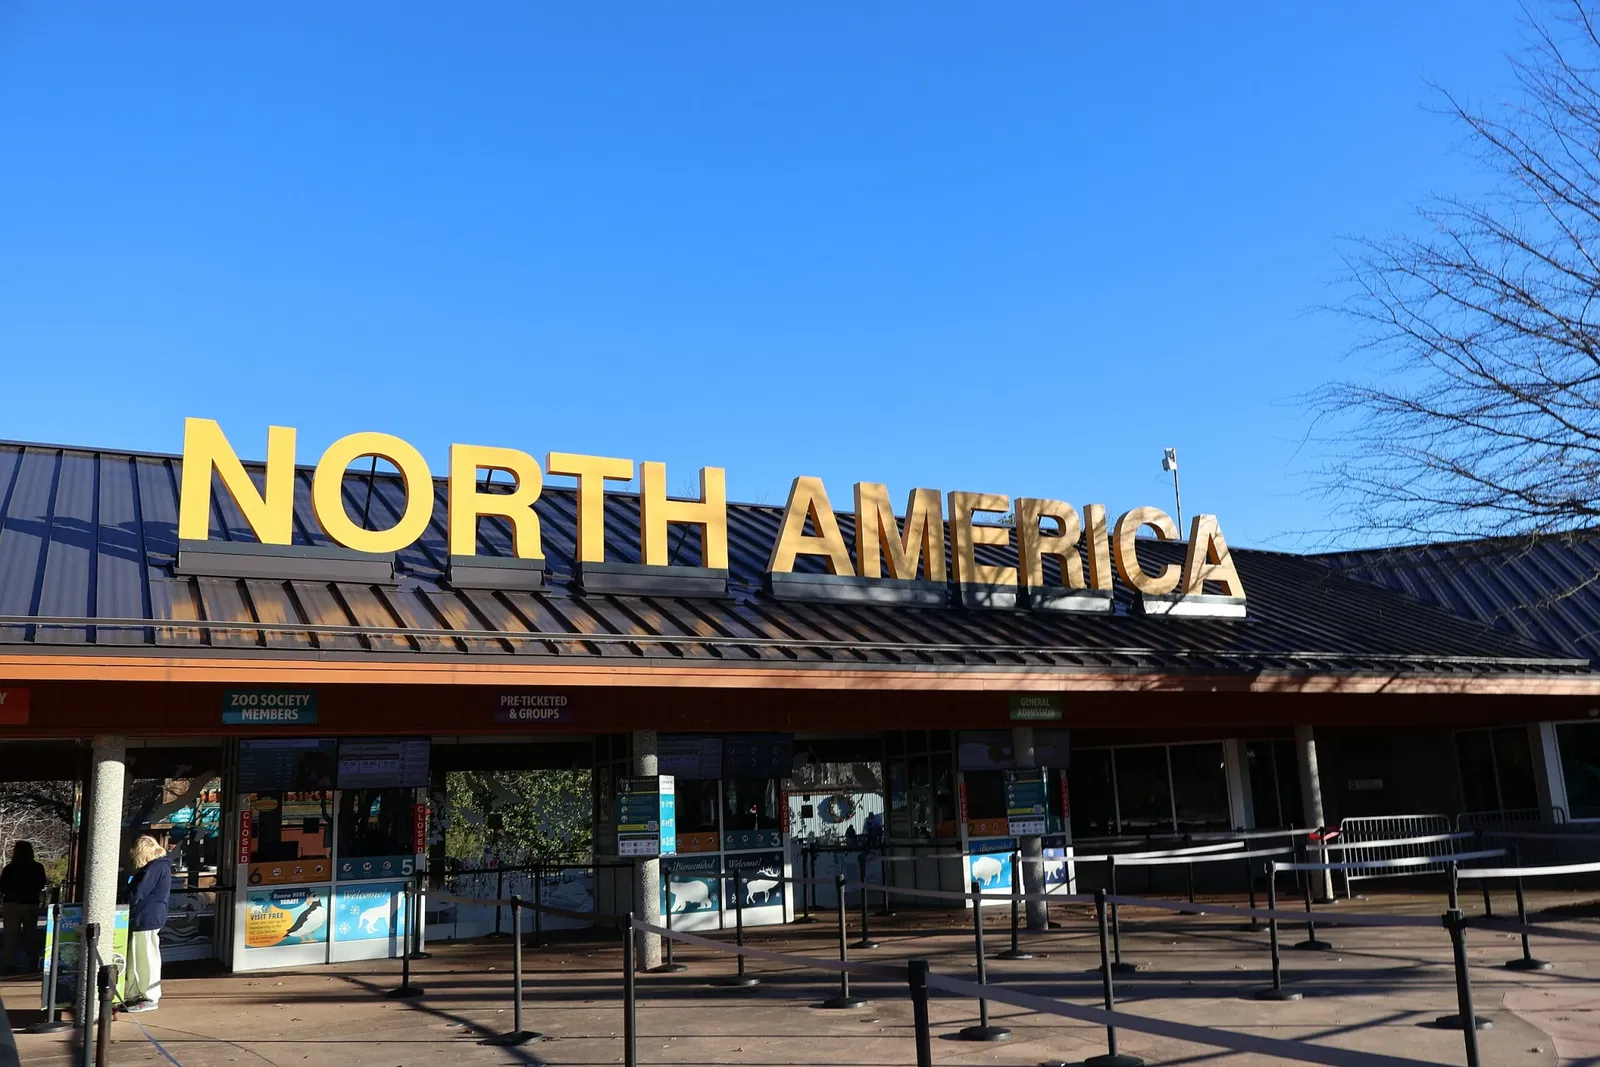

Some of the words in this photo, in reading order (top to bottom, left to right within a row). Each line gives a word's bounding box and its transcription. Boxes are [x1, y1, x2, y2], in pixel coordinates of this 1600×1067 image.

[178, 417, 729, 570] NORTH
[767, 475, 1247, 601] AMERICA
[231, 694, 258, 706] ZOO
[260, 694, 311, 706] SOCIETY
[500, 695, 568, 706] PRE-TICKETED
[1020, 697, 1050, 707] GENERAL
[241, 708, 299, 720] MEMBERS
[509, 708, 517, 719] &
[518, 708, 560, 719] GROUPS
[1017, 707, 1056, 717] ADMISSION
[771, 832, 781, 847] 3
[401, 858, 414, 876] 5
[727, 857, 763, 869] Welcome!
[249, 867, 262, 885] 6
[343, 888, 388, 901] Welcome!
[250, 913, 267, 921] VISIT
